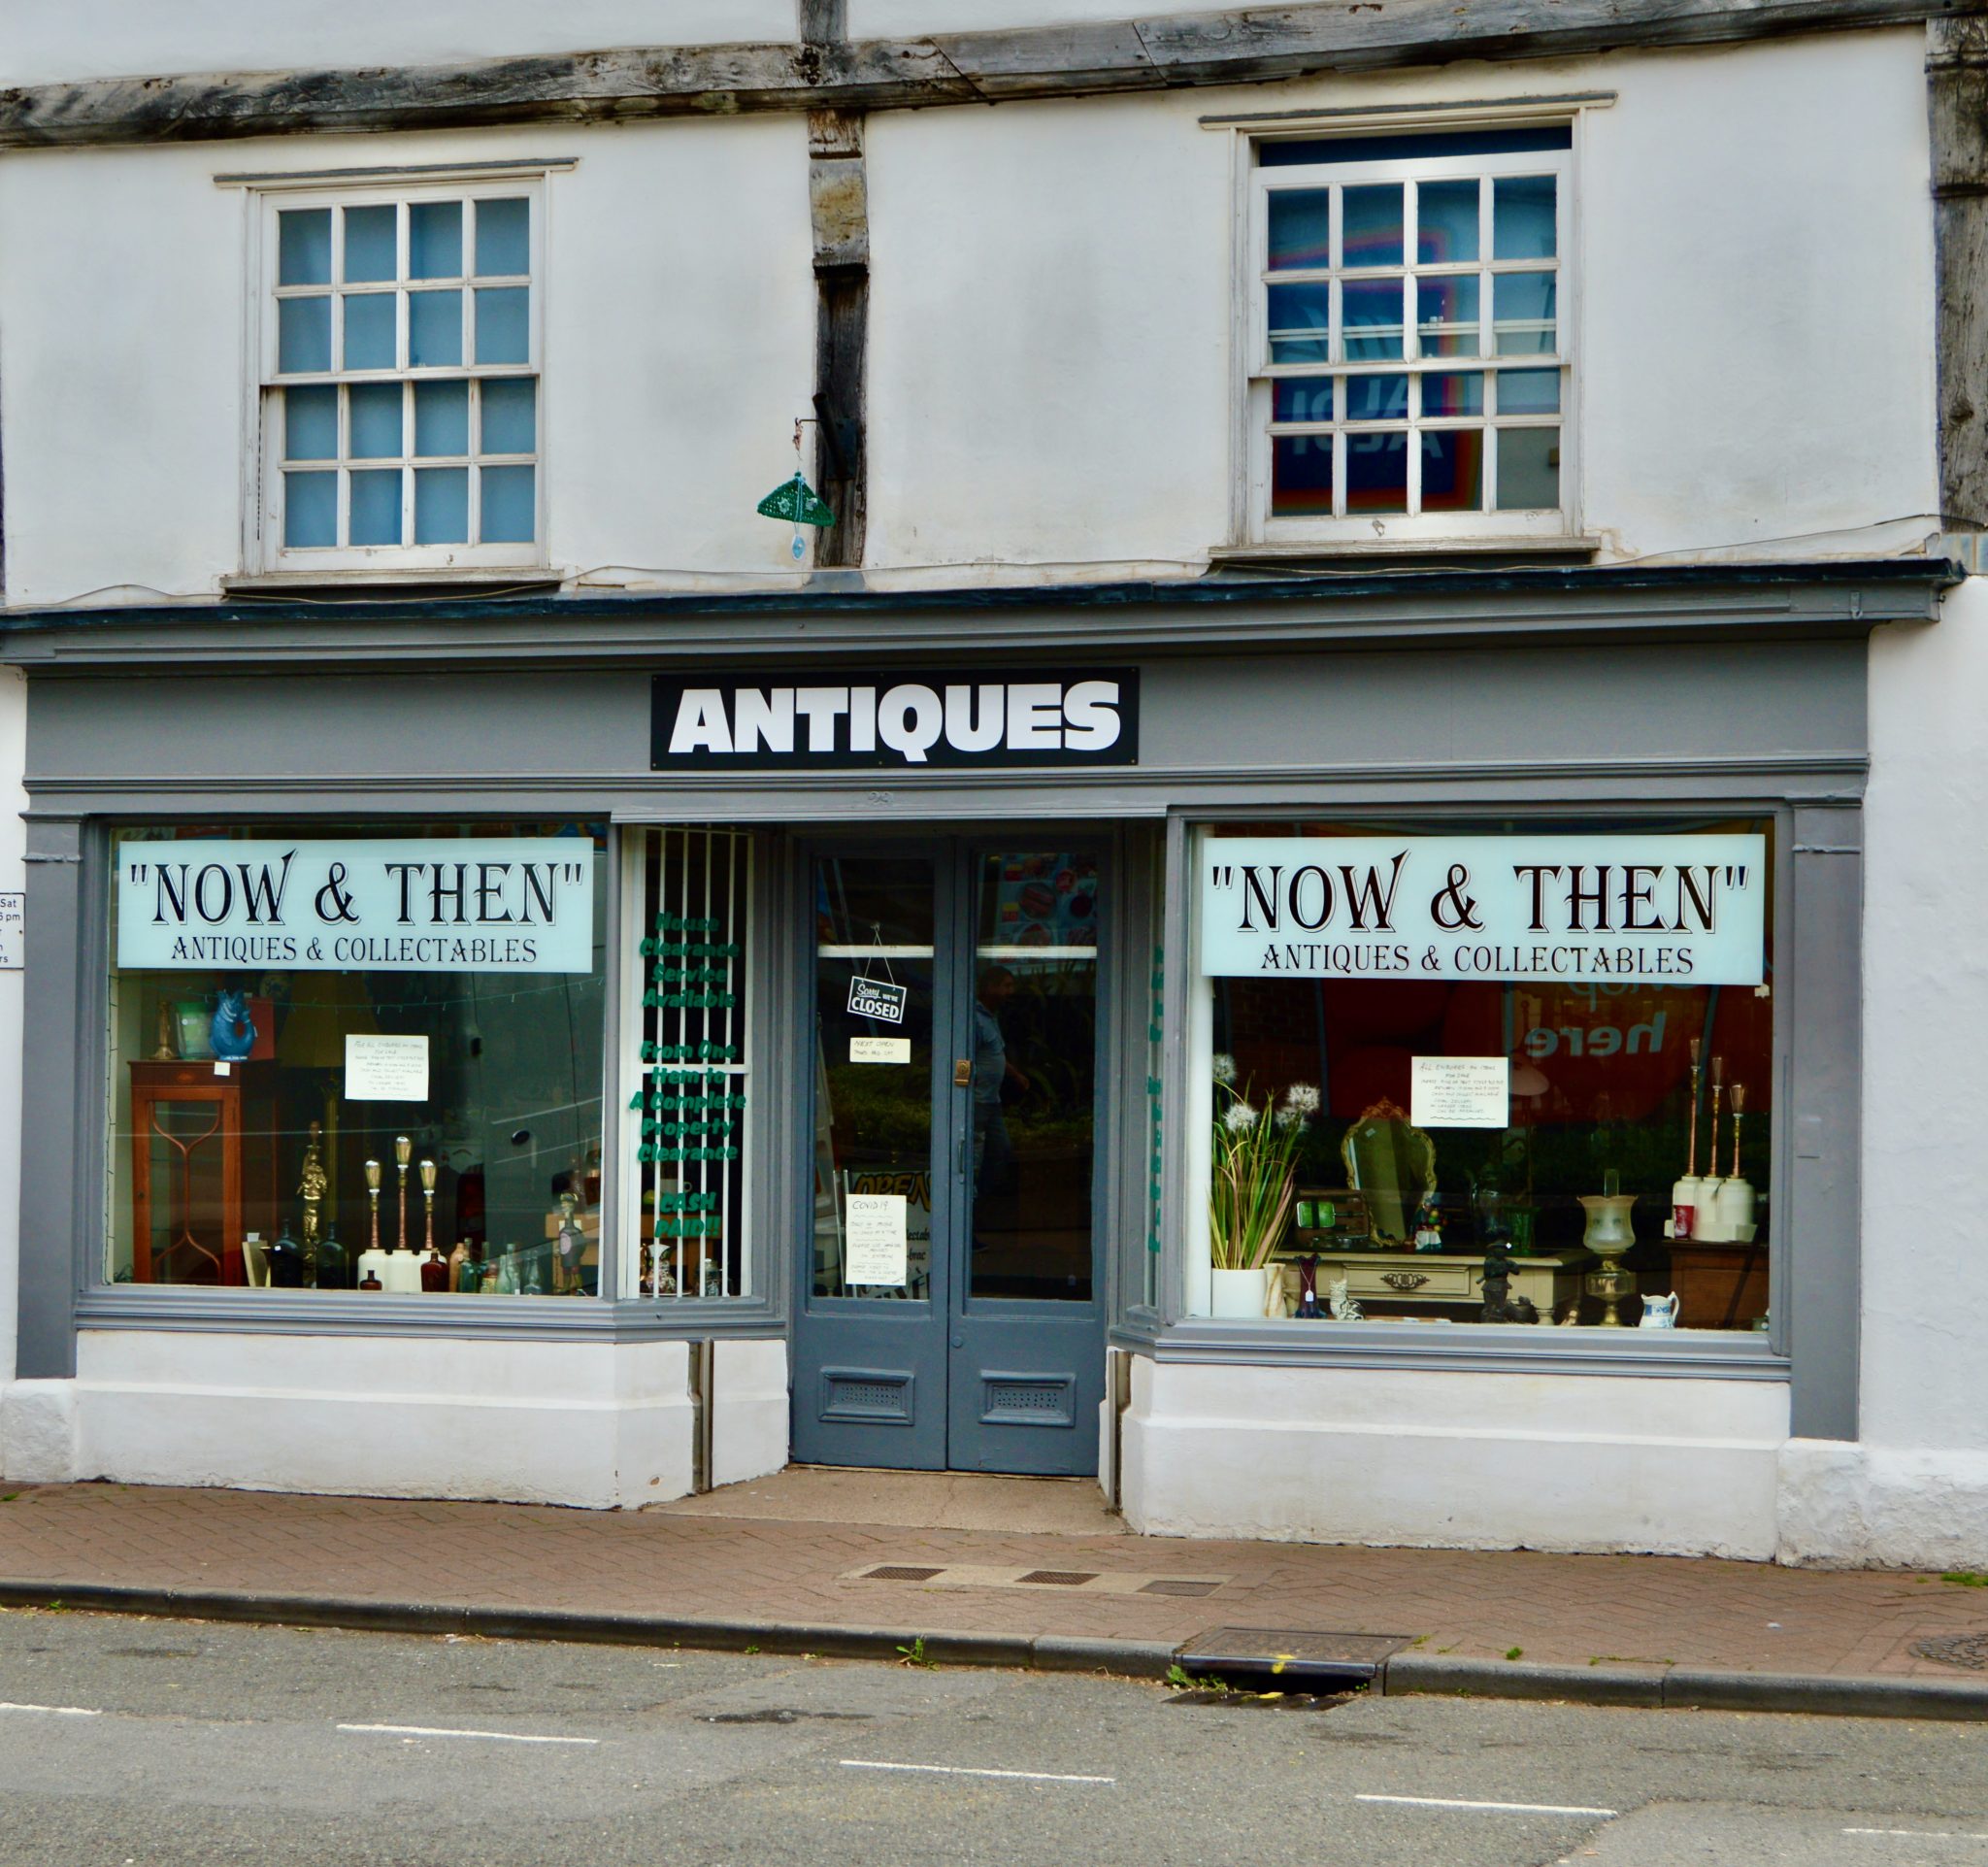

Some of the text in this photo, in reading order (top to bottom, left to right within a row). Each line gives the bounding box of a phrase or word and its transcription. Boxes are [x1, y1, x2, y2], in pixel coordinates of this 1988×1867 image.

[669, 682, 1121, 763] ANTIQUES
[314, 861, 362, 926] &
[1430, 863, 1485, 934] &
[654, 911, 719, 932] House
[171, 936, 538, 964] ANTIQUES & COLLECTABLES
[640, 937, 740, 957] Clearance
[1260, 945, 1695, 975] ANTIQUES & COLLECTABLES
[652, 962, 728, 983] Service
[642, 987, 737, 1009] Available
[856, 984, 880, 999] Sorry
[851, 997, 899, 1018] CLOSED
[640, 1039, 738, 1059] From One
[649, 1065, 727, 1085] Item to
[629, 1090, 746, 1114] A Complete
[640, 1117, 735, 1140] Property
[637, 1142, 739, 1162] Clearance
[659, 1191, 716, 1213] CASH
[654, 1216, 721, 1238] PAID!!
